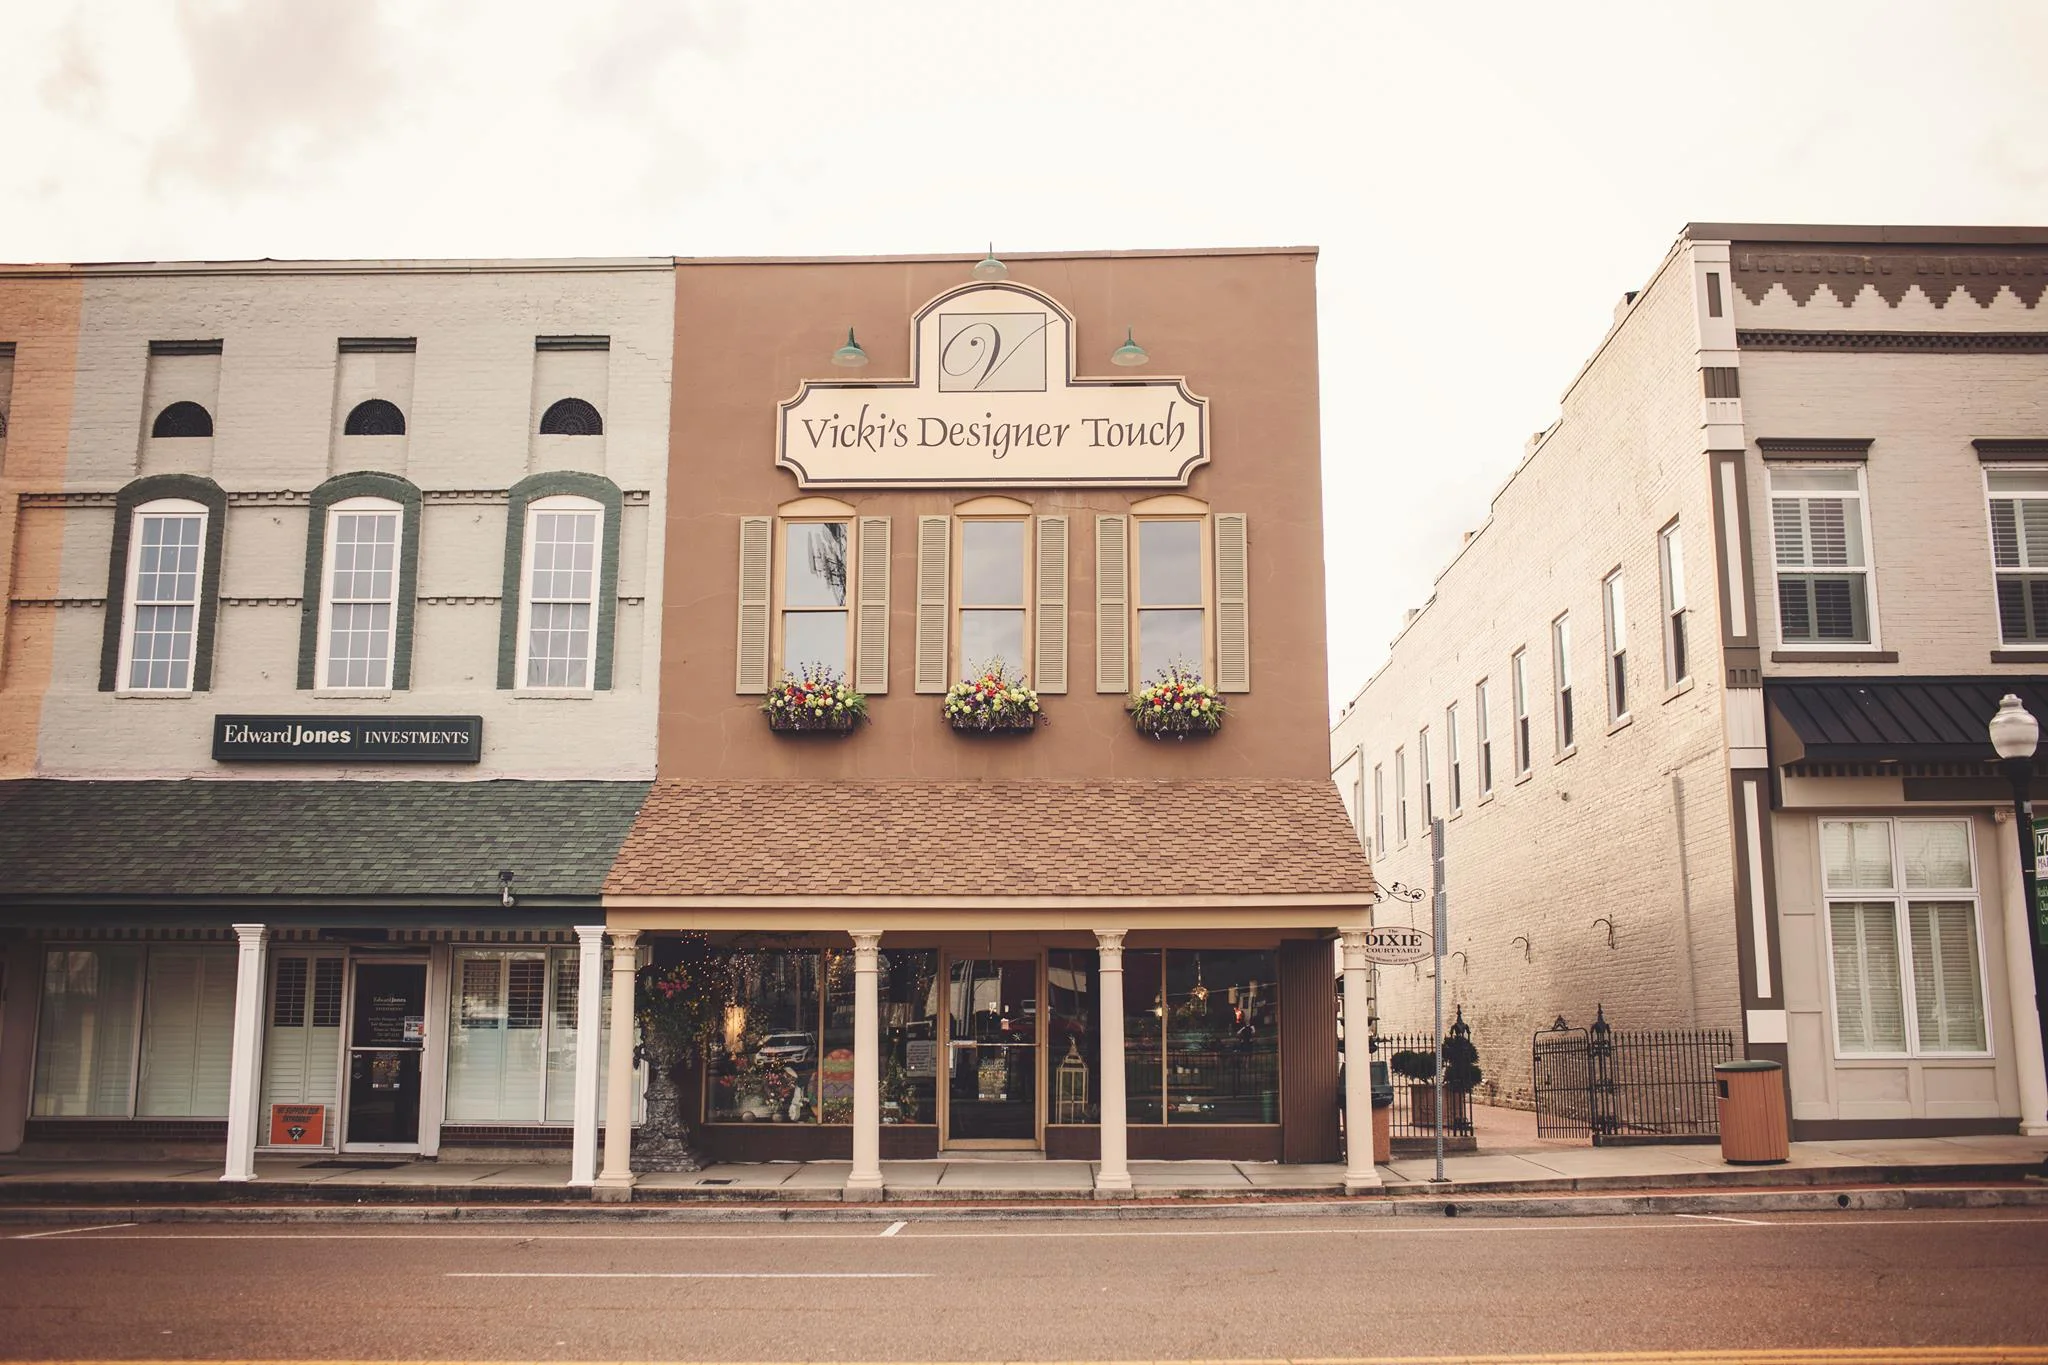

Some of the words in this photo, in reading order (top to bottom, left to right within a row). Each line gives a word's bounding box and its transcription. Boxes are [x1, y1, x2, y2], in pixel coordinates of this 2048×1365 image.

[801, 402, 908, 453] Vicki's
[917, 412, 1070, 460] Designer
[1082, 401, 1186, 452] Touch
[364, 731, 469, 744] INVESTMENTS
[1365, 934, 1422, 947] DIXIE
